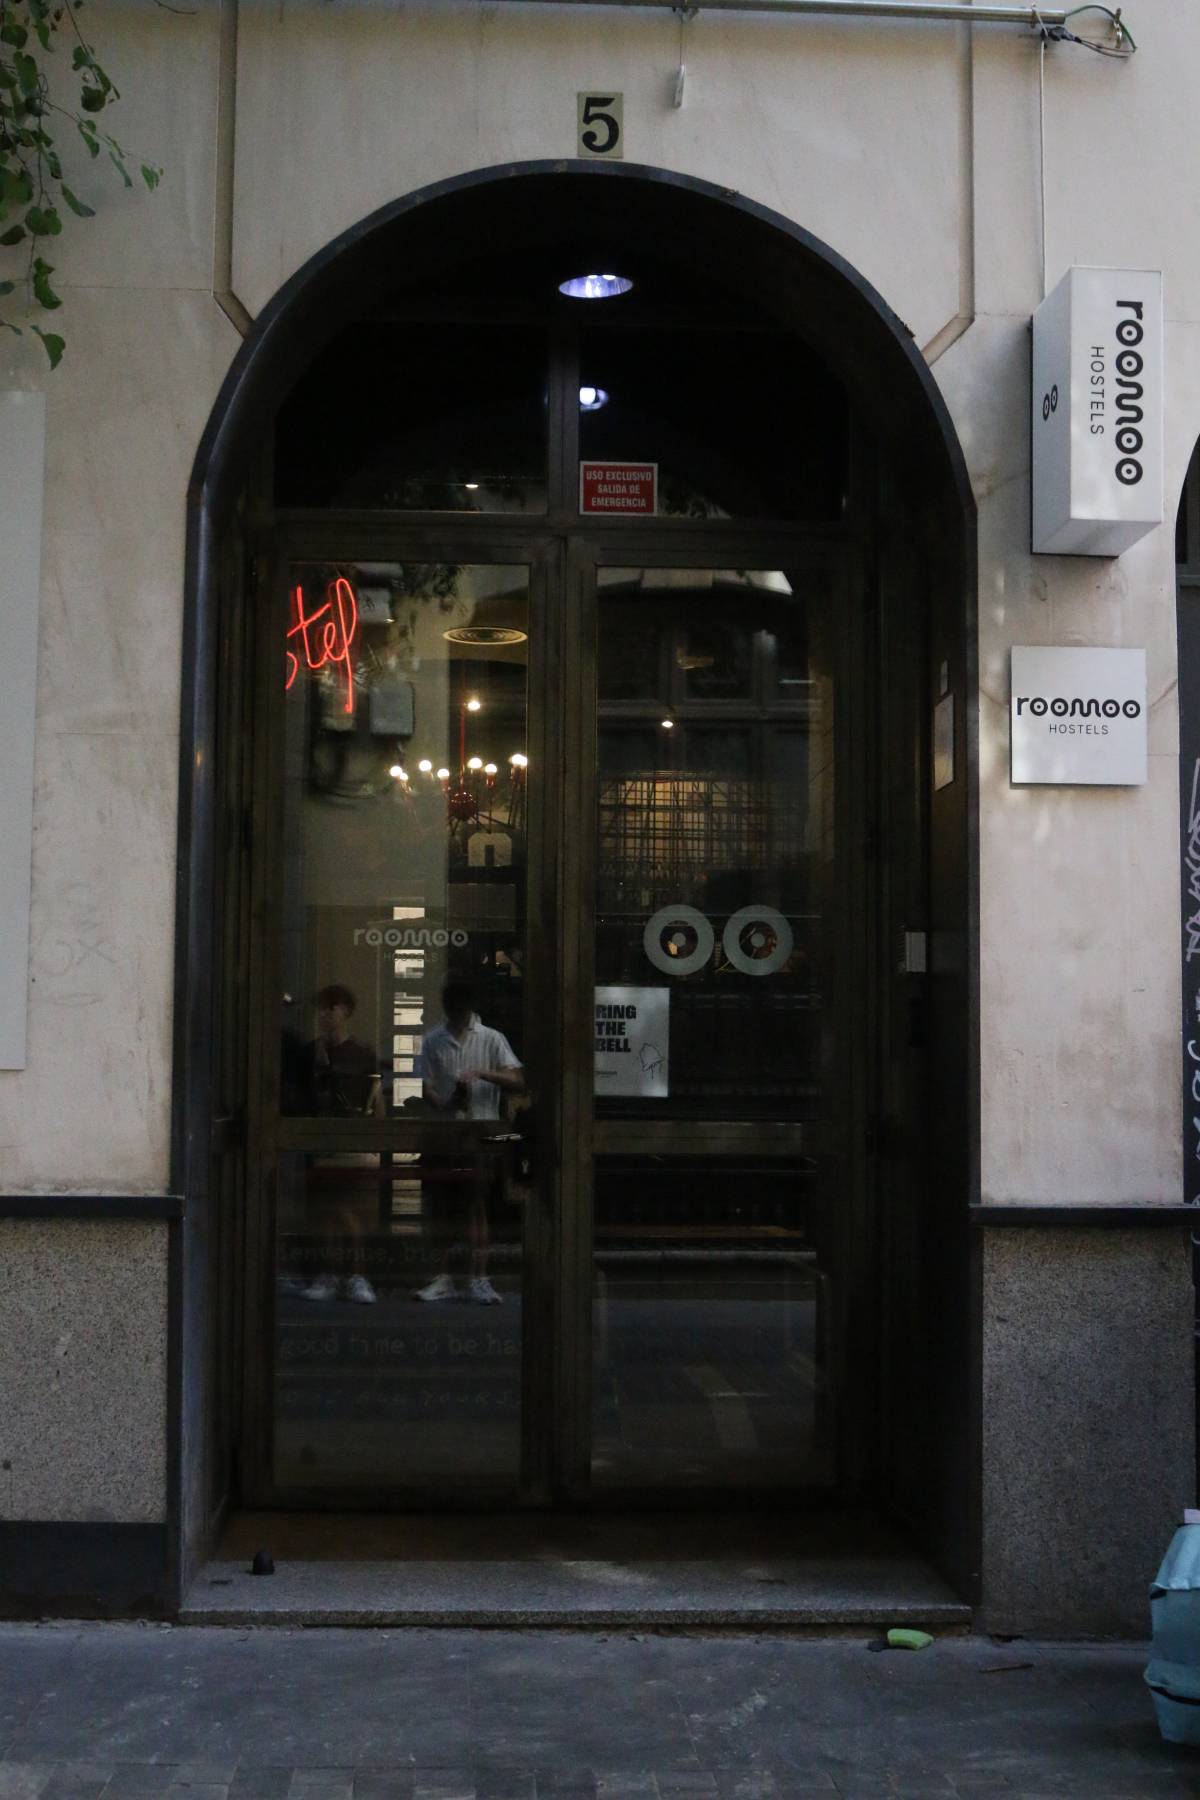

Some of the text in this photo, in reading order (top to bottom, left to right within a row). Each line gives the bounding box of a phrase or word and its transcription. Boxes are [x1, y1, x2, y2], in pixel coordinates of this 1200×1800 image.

[582, 97, 619, 153] 5
[1090, 346, 1105, 435] HOSTELS
[1115, 300, 1143, 486] roomoo
[586, 471, 652, 481] USO EXCLUSIVO
[597, 484, 641, 494] SALIDA DE
[591, 497, 647, 508] EMERGENCIA
[1017, 697, 1141, 718] roomoo
[1049, 723, 1109, 735] HOSTELS
[596, 1004, 637, 1019] RING
[595, 1021, 626, 1036] THE
[595, 1038, 632, 1053] BELL
